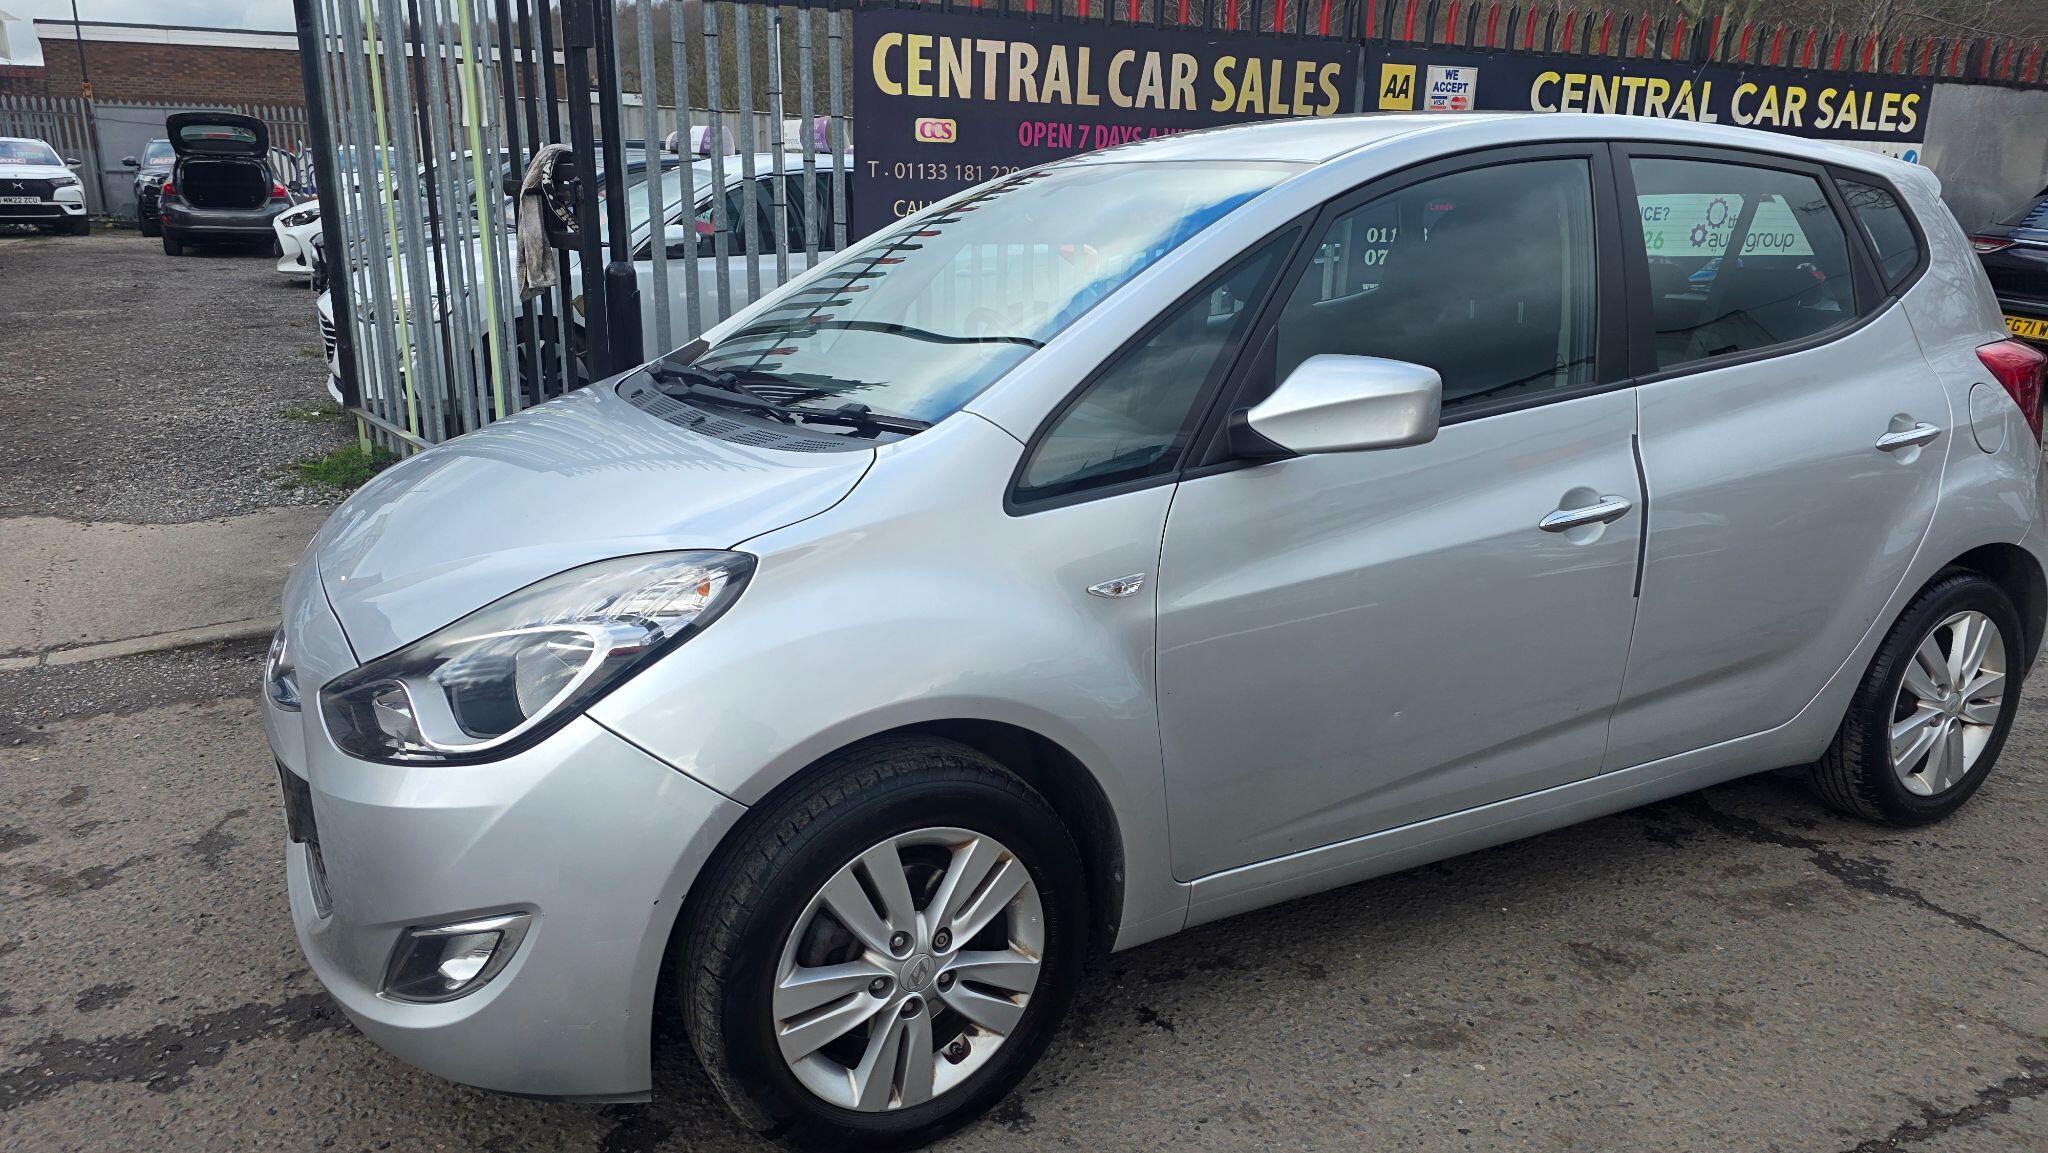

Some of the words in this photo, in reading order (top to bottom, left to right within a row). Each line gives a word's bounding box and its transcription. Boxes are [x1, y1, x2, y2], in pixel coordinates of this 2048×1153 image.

[872, 32, 1100, 106] CENTRAL
[1108, 49, 1199, 111] CAR
[1211, 55, 1341, 117] SALES
[1445, 69, 1459, 80] WE
[1383, 74, 1410, 99] AA
[1433, 81, 1469, 93] ACCEPT
[1530, 71, 1718, 123] CENTRAL
[1731, 82, 1807, 127] CAR
[1813, 87, 1921, 134] SALES
[1018, 120, 1072, 148] OPEN
[1078, 124, 1090, 149] 7
[1096, 124, 1143, 150] DAYS
[894, 162, 947, 180] 01133
[955, 164, 982, 181] 181
[1364, 249, 1389, 265] 07
